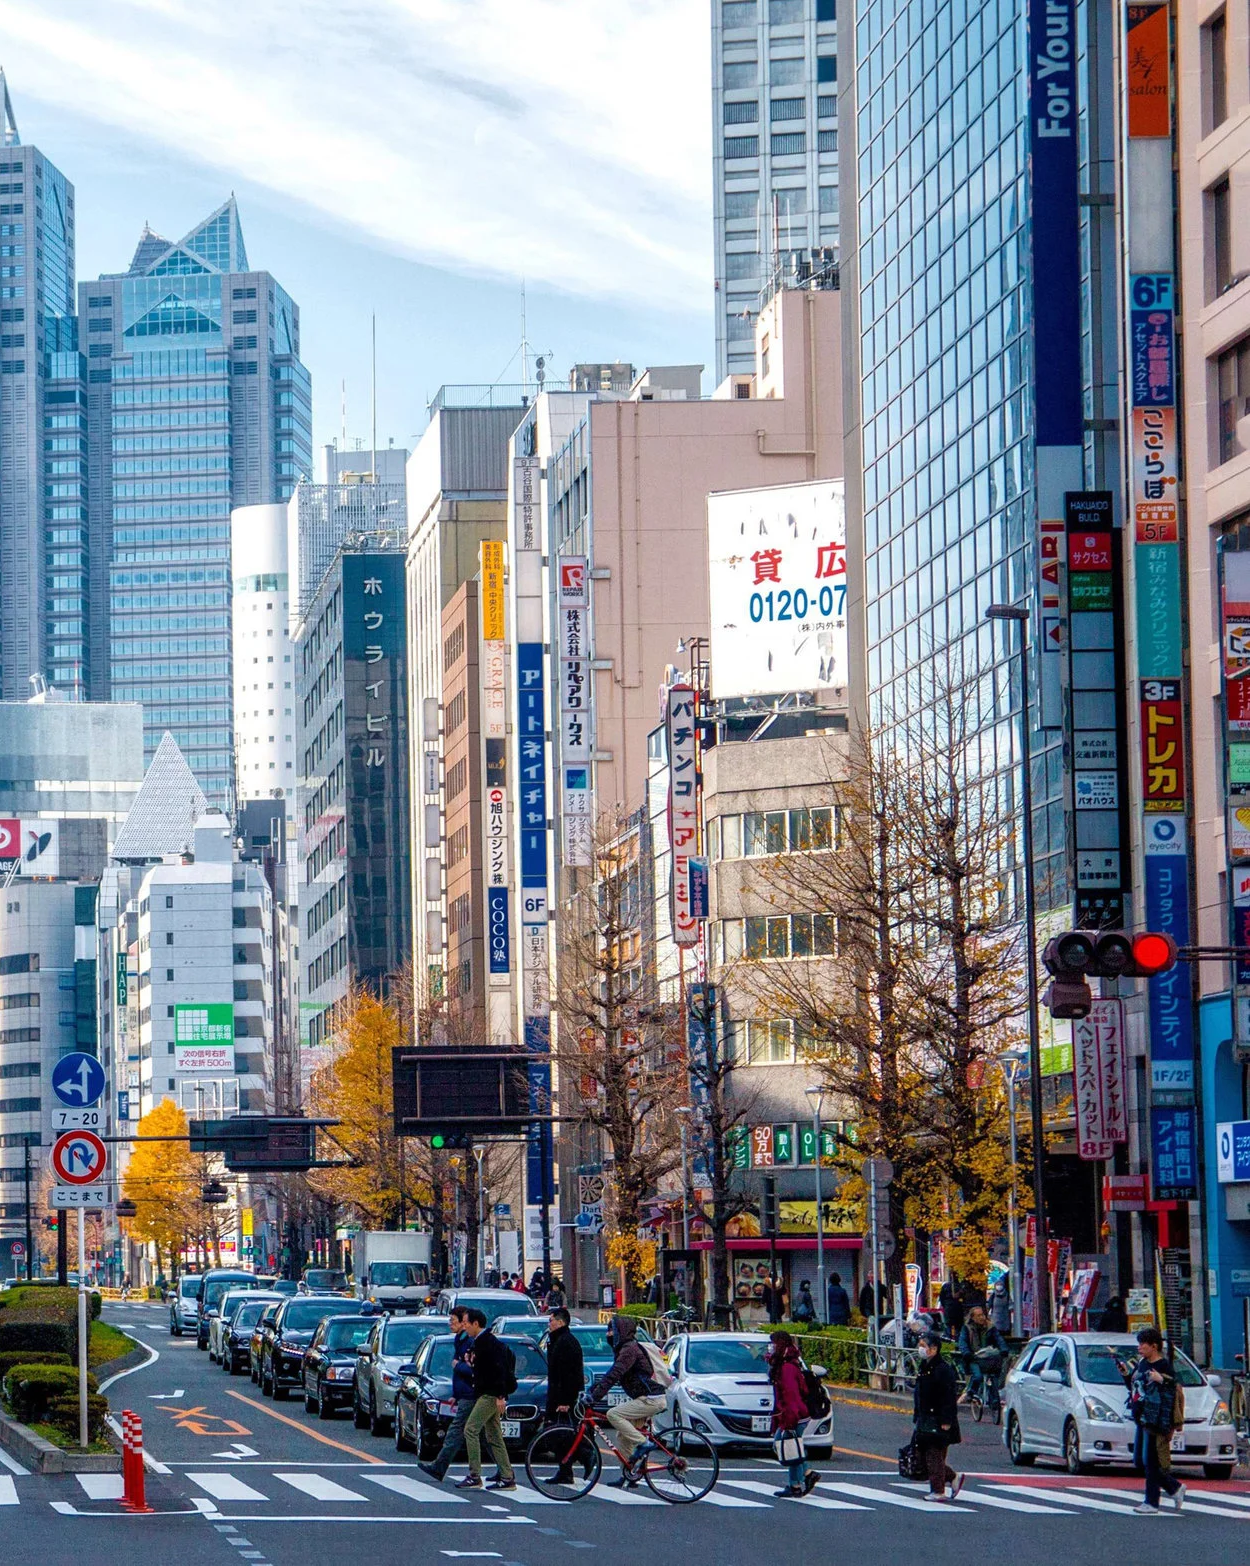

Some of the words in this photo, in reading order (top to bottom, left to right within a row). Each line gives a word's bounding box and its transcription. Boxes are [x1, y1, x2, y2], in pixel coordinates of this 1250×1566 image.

[1129, 80, 1167, 95] salon
[1037, 84, 1071, 137] For
[1133, 276, 1170, 308] 6F
[1135, 323, 1147, 400] アセットスクエア
[1070, 501, 1108, 510] HAKUAIDO
[1145, 523, 1166, 540] 5F
[1073, 552, 1108, 564] サクセス
[364, 576, 387, 768] ホウライビル
[492, 657, 503, 708] GRACE
[1145, 682, 1174, 700] 3F
[490, 723, 502, 732] 5F
[522, 669, 543, 849] アートネイチャー
[672, 701, 693, 796] パチンコ
[1147, 706, 1177, 793] トレカ
[1149, 839, 1182, 851] eyecity
[525, 898, 545, 912] 6F
[183, 1050, 226, 1058] 次の信号右折
[1077, 1025, 1099, 1138] ヘッドスパ・カット
[1103, 1027, 1121, 1122] フェイシャル
[1154, 1071, 1191, 1082] 1F/2F
[1082, 1142, 1111, 1155] 8F
[1158, 1121, 1175, 1185] アイ眼科
[1174, 1112, 1190, 1180] 新宿南口
[57, 1192, 103, 1201] ここまで
[594, 1424, 617, 1451] GIANT
